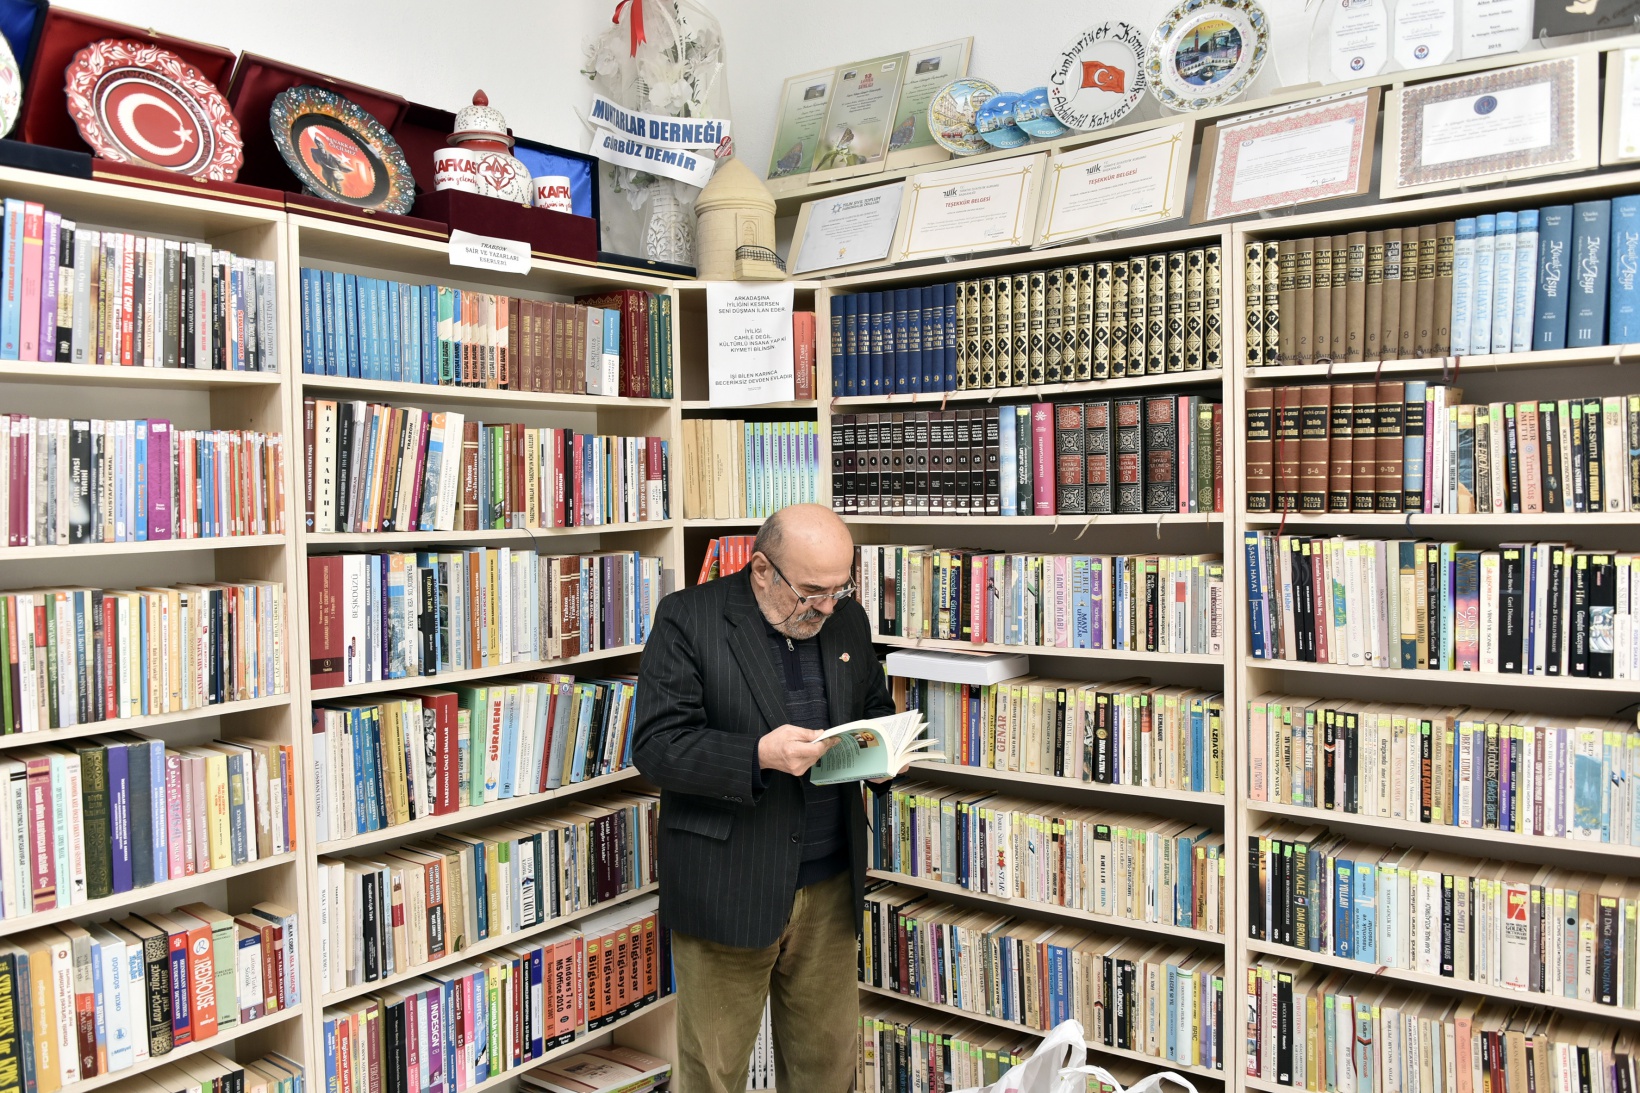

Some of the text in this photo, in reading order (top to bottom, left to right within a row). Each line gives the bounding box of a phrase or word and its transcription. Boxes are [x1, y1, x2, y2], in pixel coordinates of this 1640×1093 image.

[592, 99, 722, 144] MUHTARLAR DERNEĞİ
[1088, 98, 1129, 128] Kahveci
[434, 158, 477, 176] KAFKAS
[603, 135, 697, 171] GÜRBÜZ DEMİR
[1088, 168, 1138, 185] TEŞEKKÜR BELGESİ
[945, 196, 991, 208] TEŞEKKÜR BELGESİ
[465, 247, 479, 255] ŞAİR
[489, 250, 519, 262] YAZARLARI
[480, 242, 507, 252] TRABZON
[480, 256, 507, 266] ESERLERİ
[48, 255, 56, 271] ORDU
[1580, 259, 1598, 294] Asya
[1619, 255, 1637, 291] Asya
[1542, 262, 1561, 297] Asya
[124, 285, 133, 312] VE CHP
[237, 309, 245, 360] SARIKAMIŞ
[1350, 332, 1356, 340] 5
[1386, 330, 1392, 338] 7
[1403, 330, 1409, 339] 8
[1436, 327, 1447, 336] 10
[1544, 332, 1552, 342] II
[1578, 329, 1591, 339] III
[72, 457, 81, 483] SİYASİ
[1307, 467, 1319, 475] 5-6
[1526, 454, 1536, 500] Yırtıcı Kuş
[1250, 569, 1258, 593] HAYAT
[1284, 583, 1291, 592] Ne
[1467, 559, 1477, 591] WILBUR
[351, 573, 360, 619] BEŞİKDÜZÜ
[489, 700, 502, 762] SÜRMENE
[997, 715, 1007, 753] GENAR
[1305, 749, 1314, 768] SMITH
[1461, 756, 1471, 782] LUDLUM
[1422, 758, 1432, 807] KAN ÇANAĞI
[169, 770, 177, 788] BANA
[173, 842, 181, 862] ANLAT
[1296, 874, 1305, 895] KALE
[1339, 884, 1349, 908] YOLLARI
[522, 885, 535, 923] LUDLUM
[1296, 907, 1305, 947] DAN BROWN
[1457, 910, 1465, 934] SMITH
[644, 931, 655, 985] Bilgisayar
[1603, 938, 1611, 956] GAO
[129, 955, 138, 980] BÜYÜK
[602, 949, 614, 1006] Bilgisayar
[617, 943, 628, 999] Bilgisayar
[630, 935, 641, 992] Bilgisayar
[111, 956, 122, 1011] OKUL SÖZLÜĞÜ
[150, 964, 163, 1022] ARAPÇA-TÜRKÇE
[161, 969, 169, 994] KÂMUS
[194, 959, 214, 1011] REDHOUSE
[556, 958, 564, 1012] MS Office 2010
[565, 955, 573, 1009] Windows ve
[587, 954, 599, 1011] Bilgisayar
[60, 998, 68, 1023] Türkçesi
[431, 1003, 440, 1047] INDESIGN
[0, 974, 18, 1086] STRATEGIES for KPDS
[41, 1040, 49, 1069] FONO
